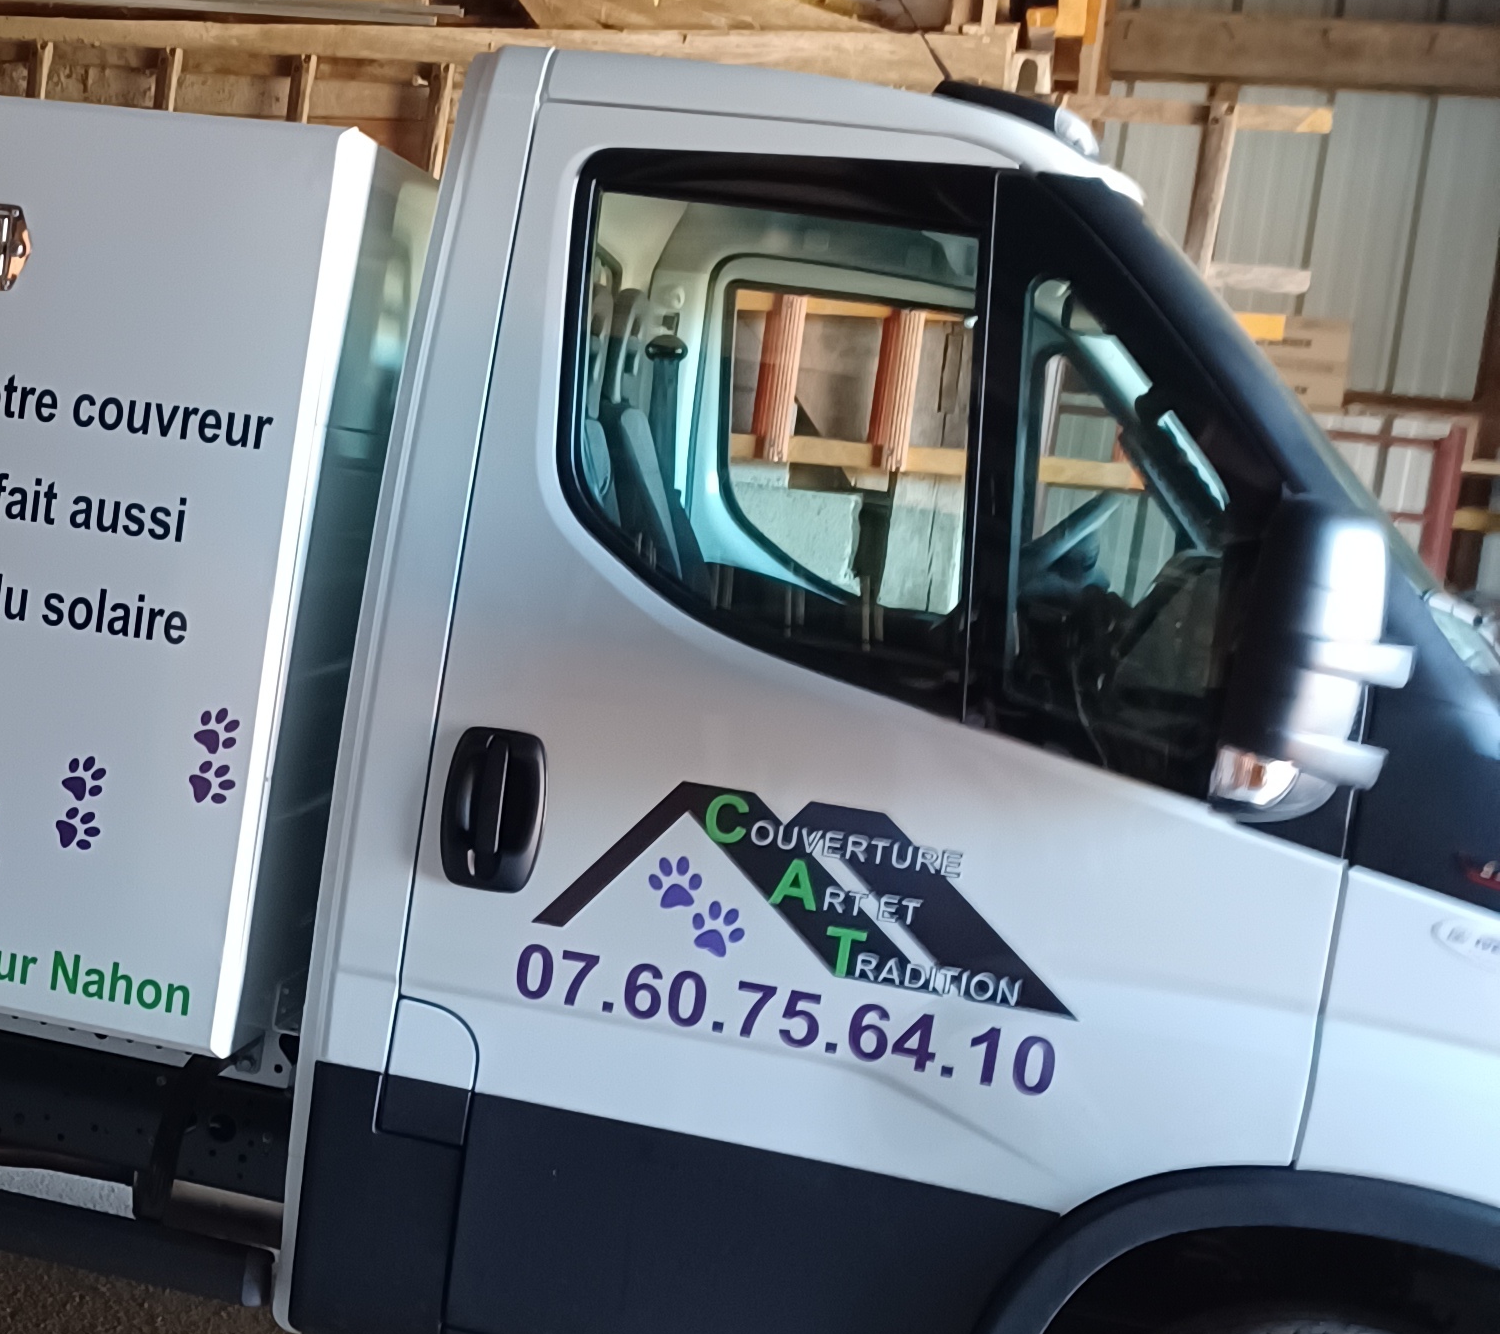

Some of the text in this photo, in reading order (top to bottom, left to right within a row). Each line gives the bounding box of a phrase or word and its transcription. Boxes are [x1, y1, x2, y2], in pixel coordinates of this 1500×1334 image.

[73, 393, 274, 450] couvreur
[69, 495, 187, 543] aussi
[41, 588, 187, 645] solaire
[50, 950, 190, 1017] Nahon
[516, 942, 1057, 1097] 07.60.75.64.10
